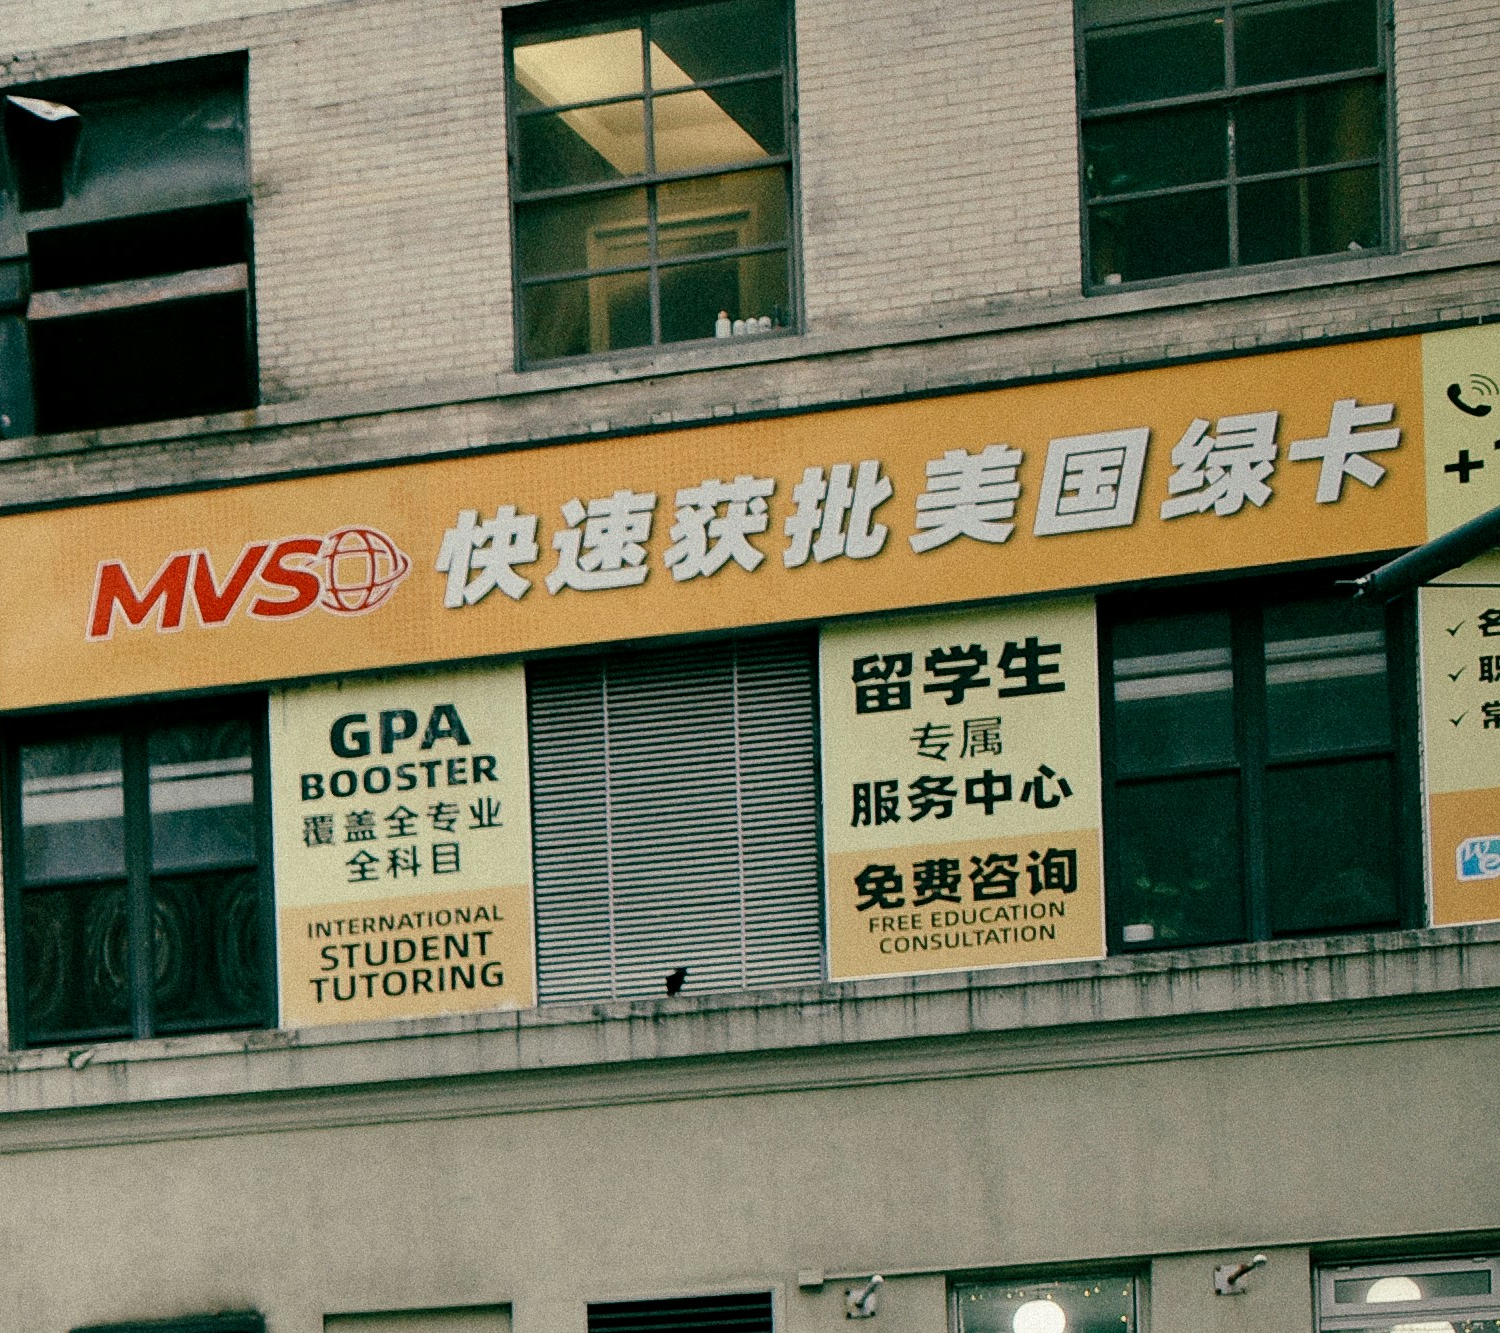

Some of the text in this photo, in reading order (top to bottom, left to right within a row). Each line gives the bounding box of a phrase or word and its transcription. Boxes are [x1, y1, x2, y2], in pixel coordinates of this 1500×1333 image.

[435, 399, 1401, 609] 快速获批美国绿卡
[851, 636, 1066, 715] 留学生
[330, 704, 471, 758] GPA
[909, 716, 1003, 762] 专属
[301, 755, 499, 801] BOOSTER
[850, 764, 1073, 827] 服务中心
[302, 796, 503, 847] 覆盖全专业
[346, 842, 461, 883] 全科目
[854, 848, 1078, 912] 免费咨询
[308, 905, 504, 938] INTERNATIONAL
[869, 901, 1066, 934] FREE EDUCATION
[879, 923, 1056, 954] CONSULTATION
[321, 931, 493, 972] STUDENT
[310, 962, 504, 1004] TUTORING
